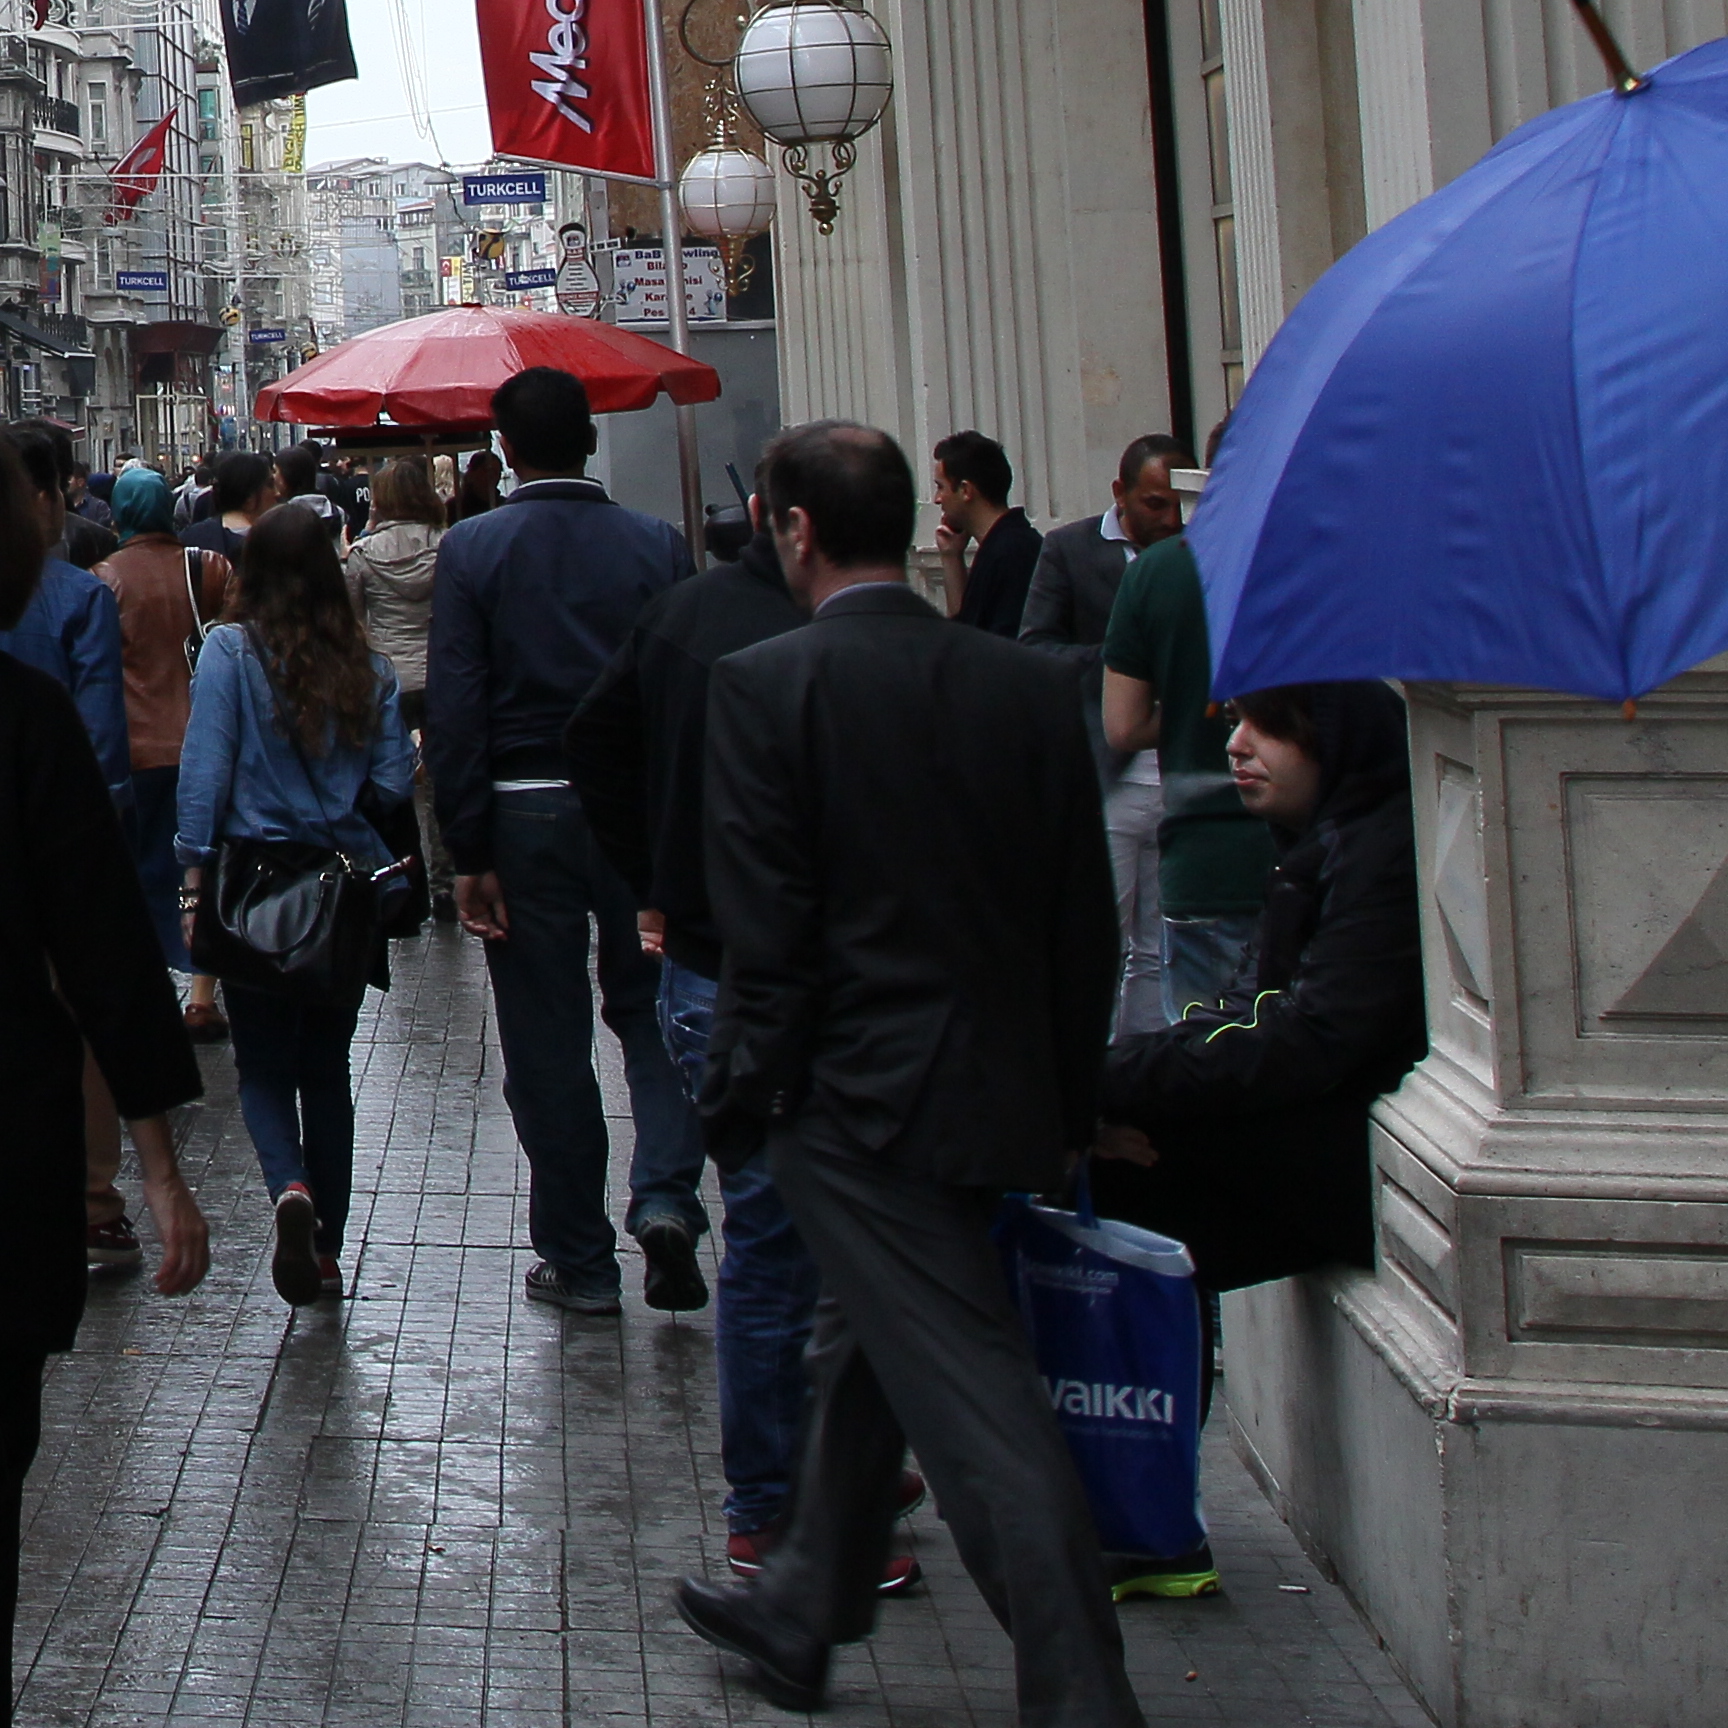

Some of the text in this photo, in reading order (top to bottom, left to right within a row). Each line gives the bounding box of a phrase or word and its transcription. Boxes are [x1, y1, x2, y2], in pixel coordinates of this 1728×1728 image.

[467, 181, 541, 197] TURKCELL
[635, 250, 662, 260] BaB
[119, 276, 165, 286] TURKCELL
[634, 276, 665, 286] Masa
[644, 308, 664, 317] Pes
